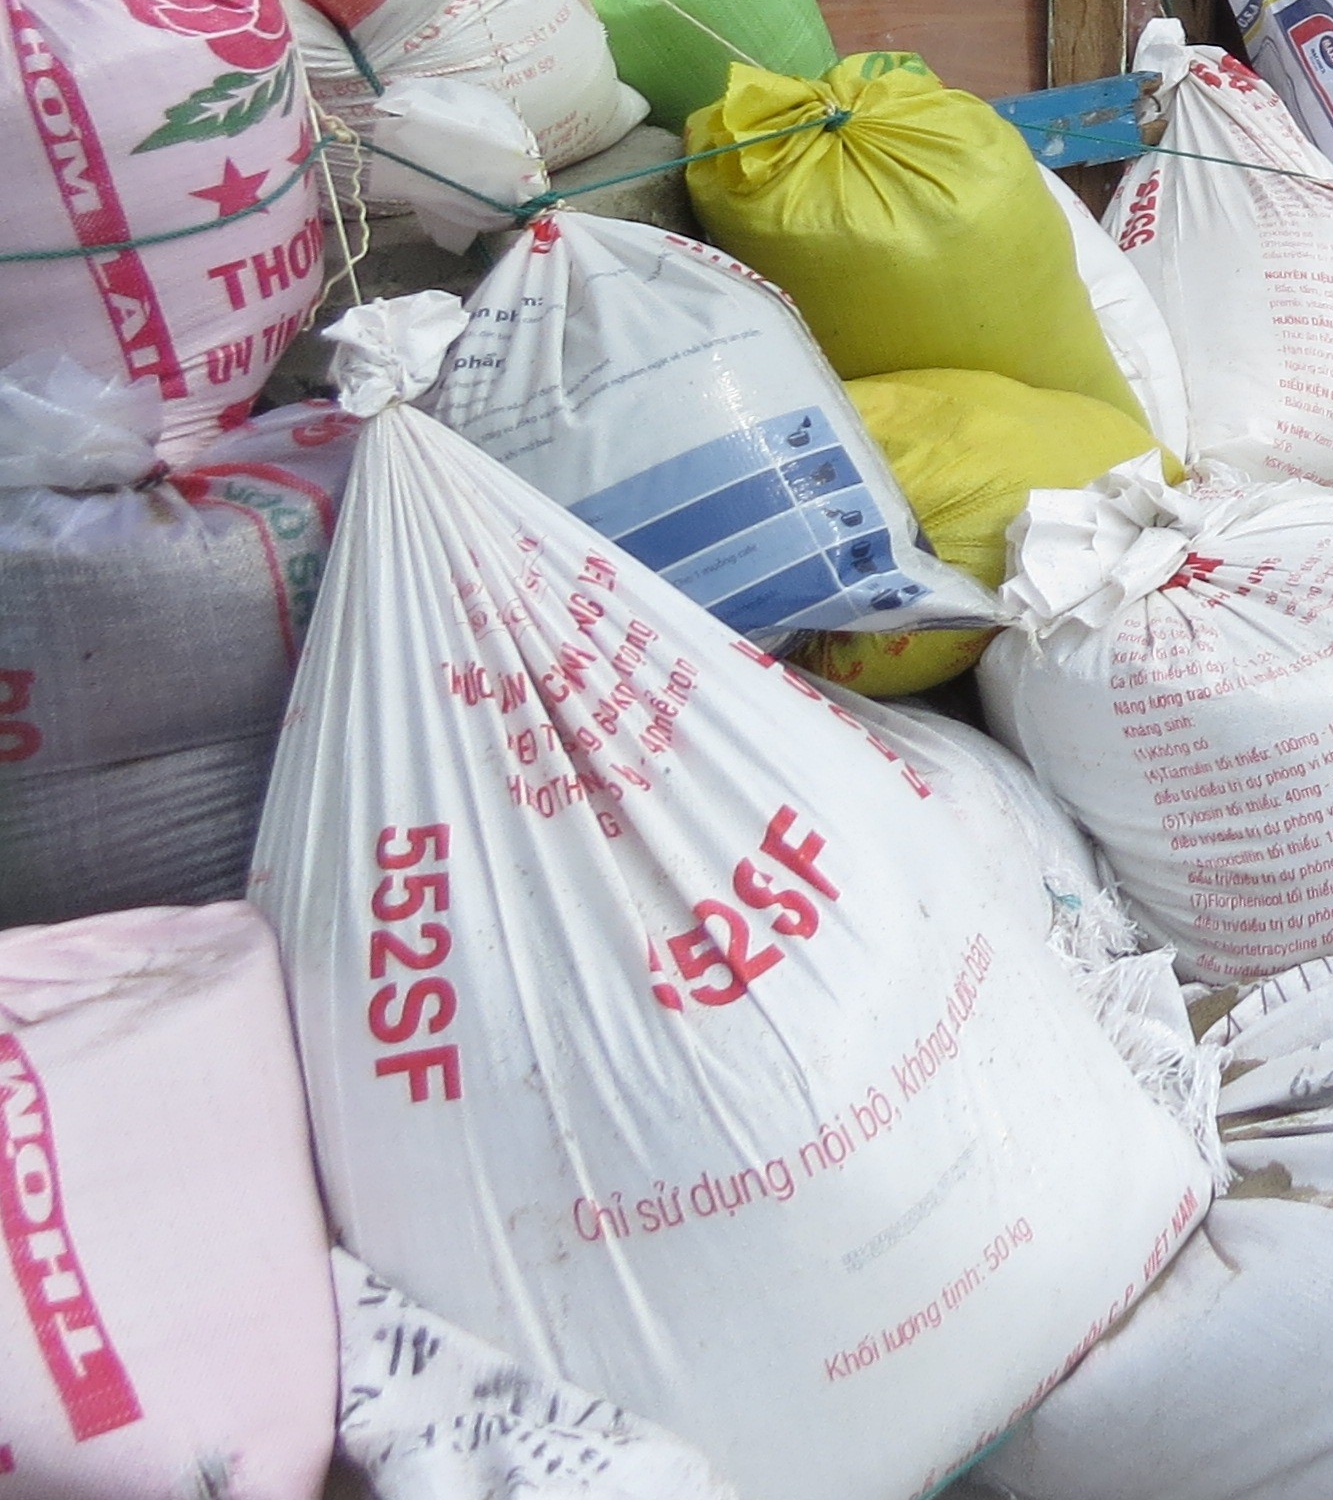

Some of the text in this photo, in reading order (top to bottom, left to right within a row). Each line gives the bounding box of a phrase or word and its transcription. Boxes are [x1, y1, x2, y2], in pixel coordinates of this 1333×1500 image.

[1123, 722, 1163, 738] Kháng
[1274, 734, 1319, 756] 100mg
[1285, 785, 1322, 803] 40mg
[367, 823, 463, 1102] 552SF
[573, 1191, 630, 1244] Chỉ
[638, 1181, 684, 1233] sử
[689, 1156, 797, 1222] dụng
[799, 1126, 857, 1173] nội
[823, 1334, 882, 1383] Khối
[882, 1303, 945, 1357] lượng
